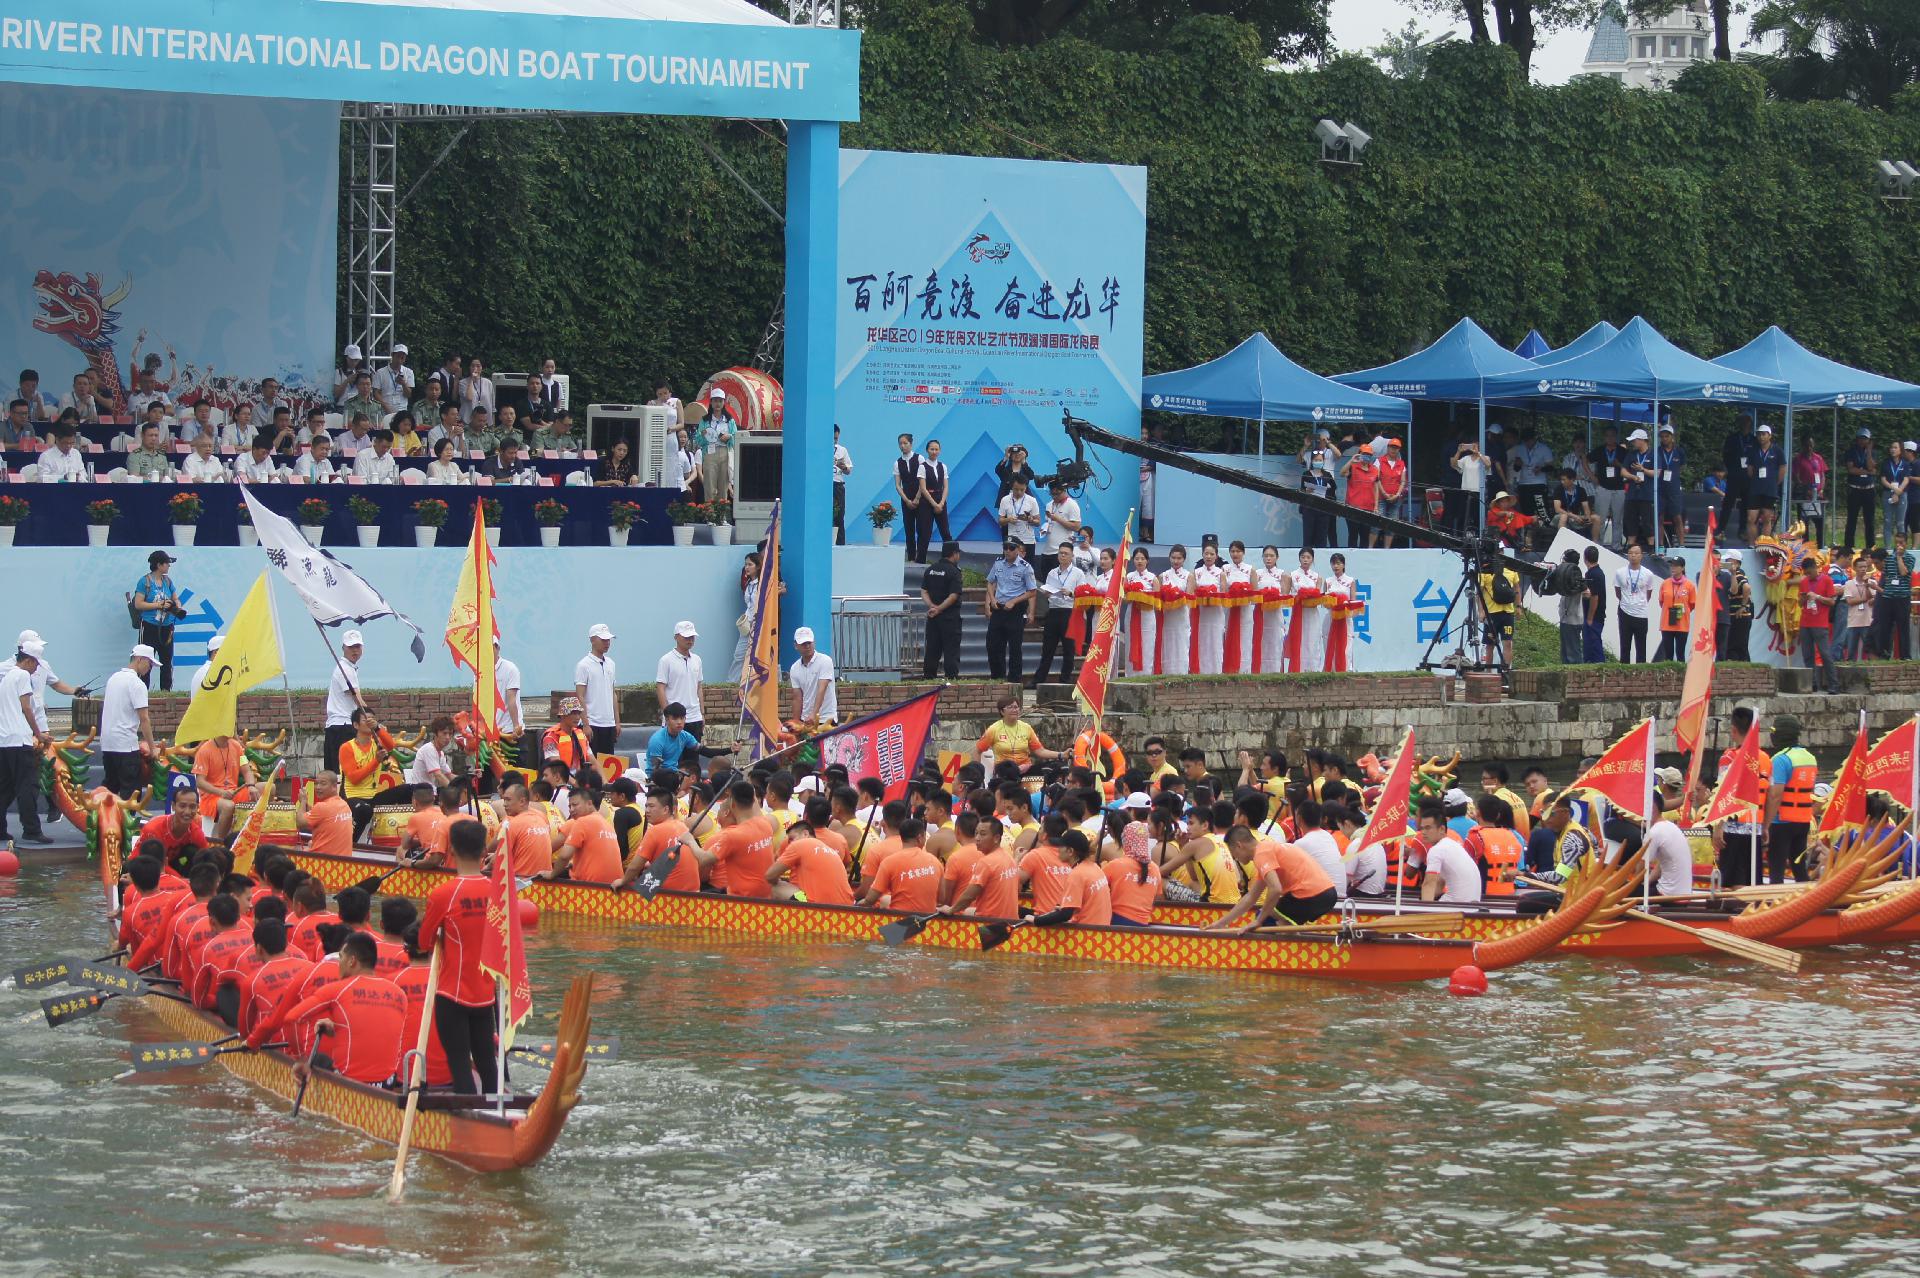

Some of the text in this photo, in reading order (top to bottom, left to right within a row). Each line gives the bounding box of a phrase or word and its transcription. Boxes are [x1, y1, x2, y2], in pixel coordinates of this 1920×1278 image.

[2, 18, 809, 89] RIVER INTERNATIONAL DRAGON BOAT TOURNAMENT
